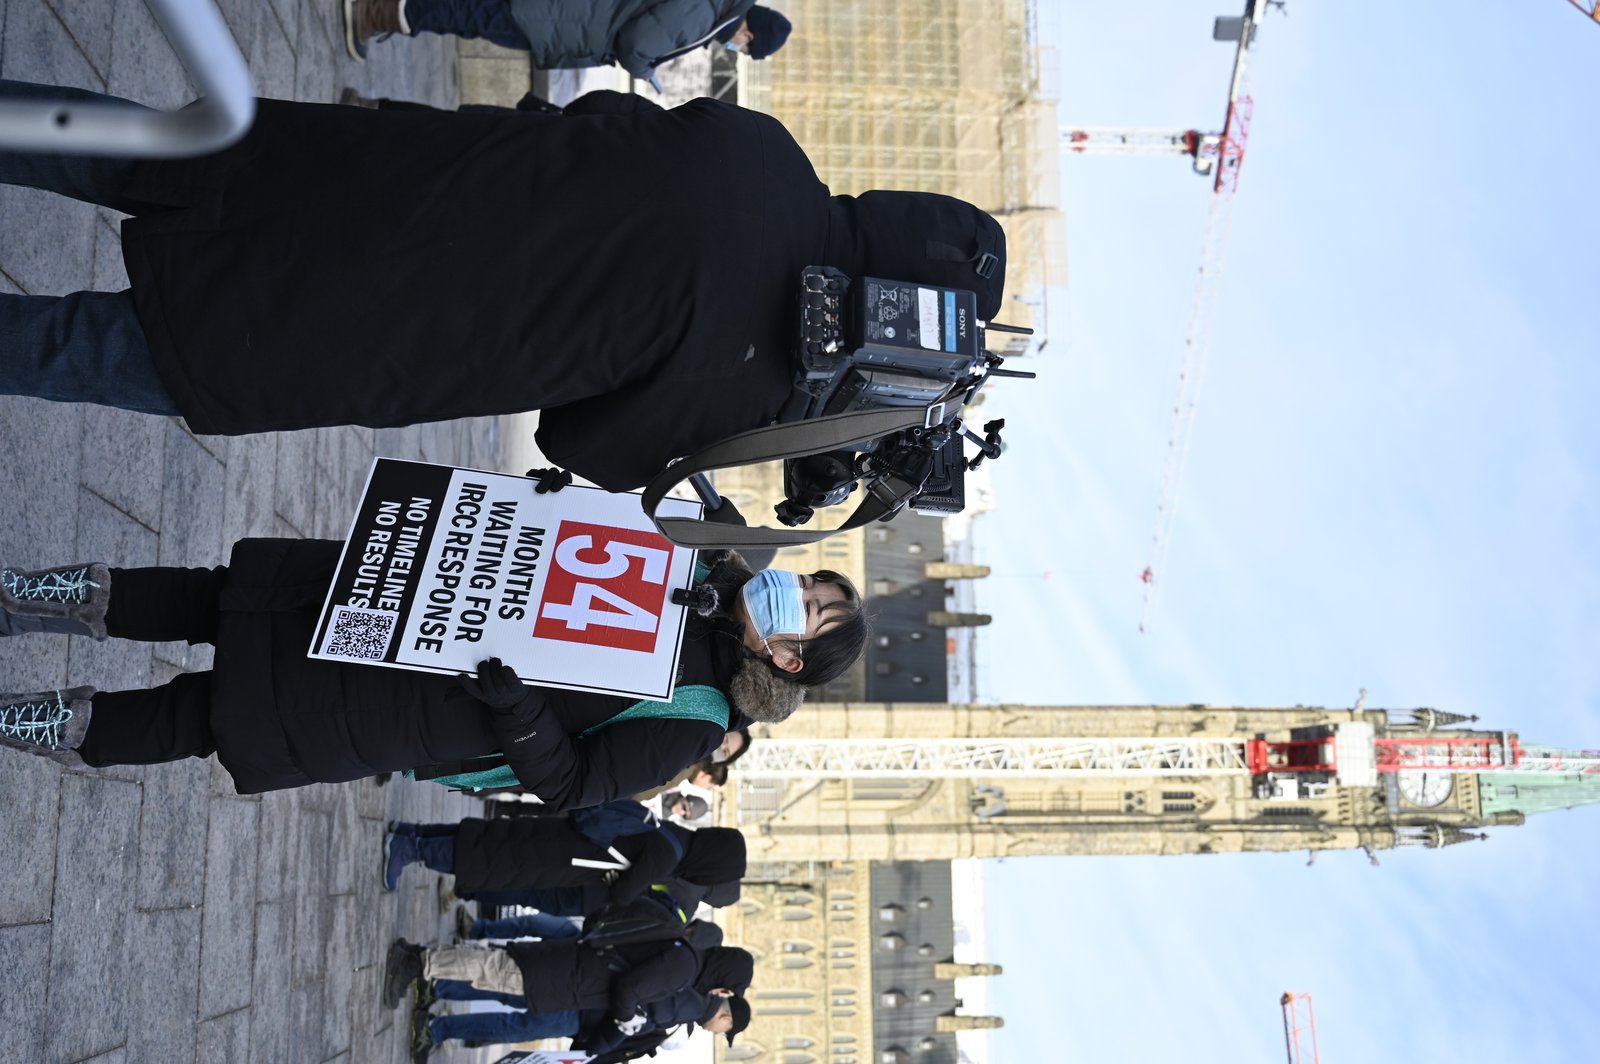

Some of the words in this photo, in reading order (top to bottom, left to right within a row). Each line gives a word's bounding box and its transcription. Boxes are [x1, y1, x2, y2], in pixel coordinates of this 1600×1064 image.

[958, 308, 966, 338] SONY
[376, 501, 401, 526] NO
[406, 497, 432, 522] NO
[452, 482, 488, 528] IRCC
[348, 530, 392, 608] RESULTS
[377, 526, 423, 612] TIMELINE
[469, 502, 518, 590] WAITING
[498, 526, 546, 620] MONTHS
[542, 535, 670, 632] 54
[414, 531, 473, 653] RESPONSE
[454, 596, 492, 642] FOR
